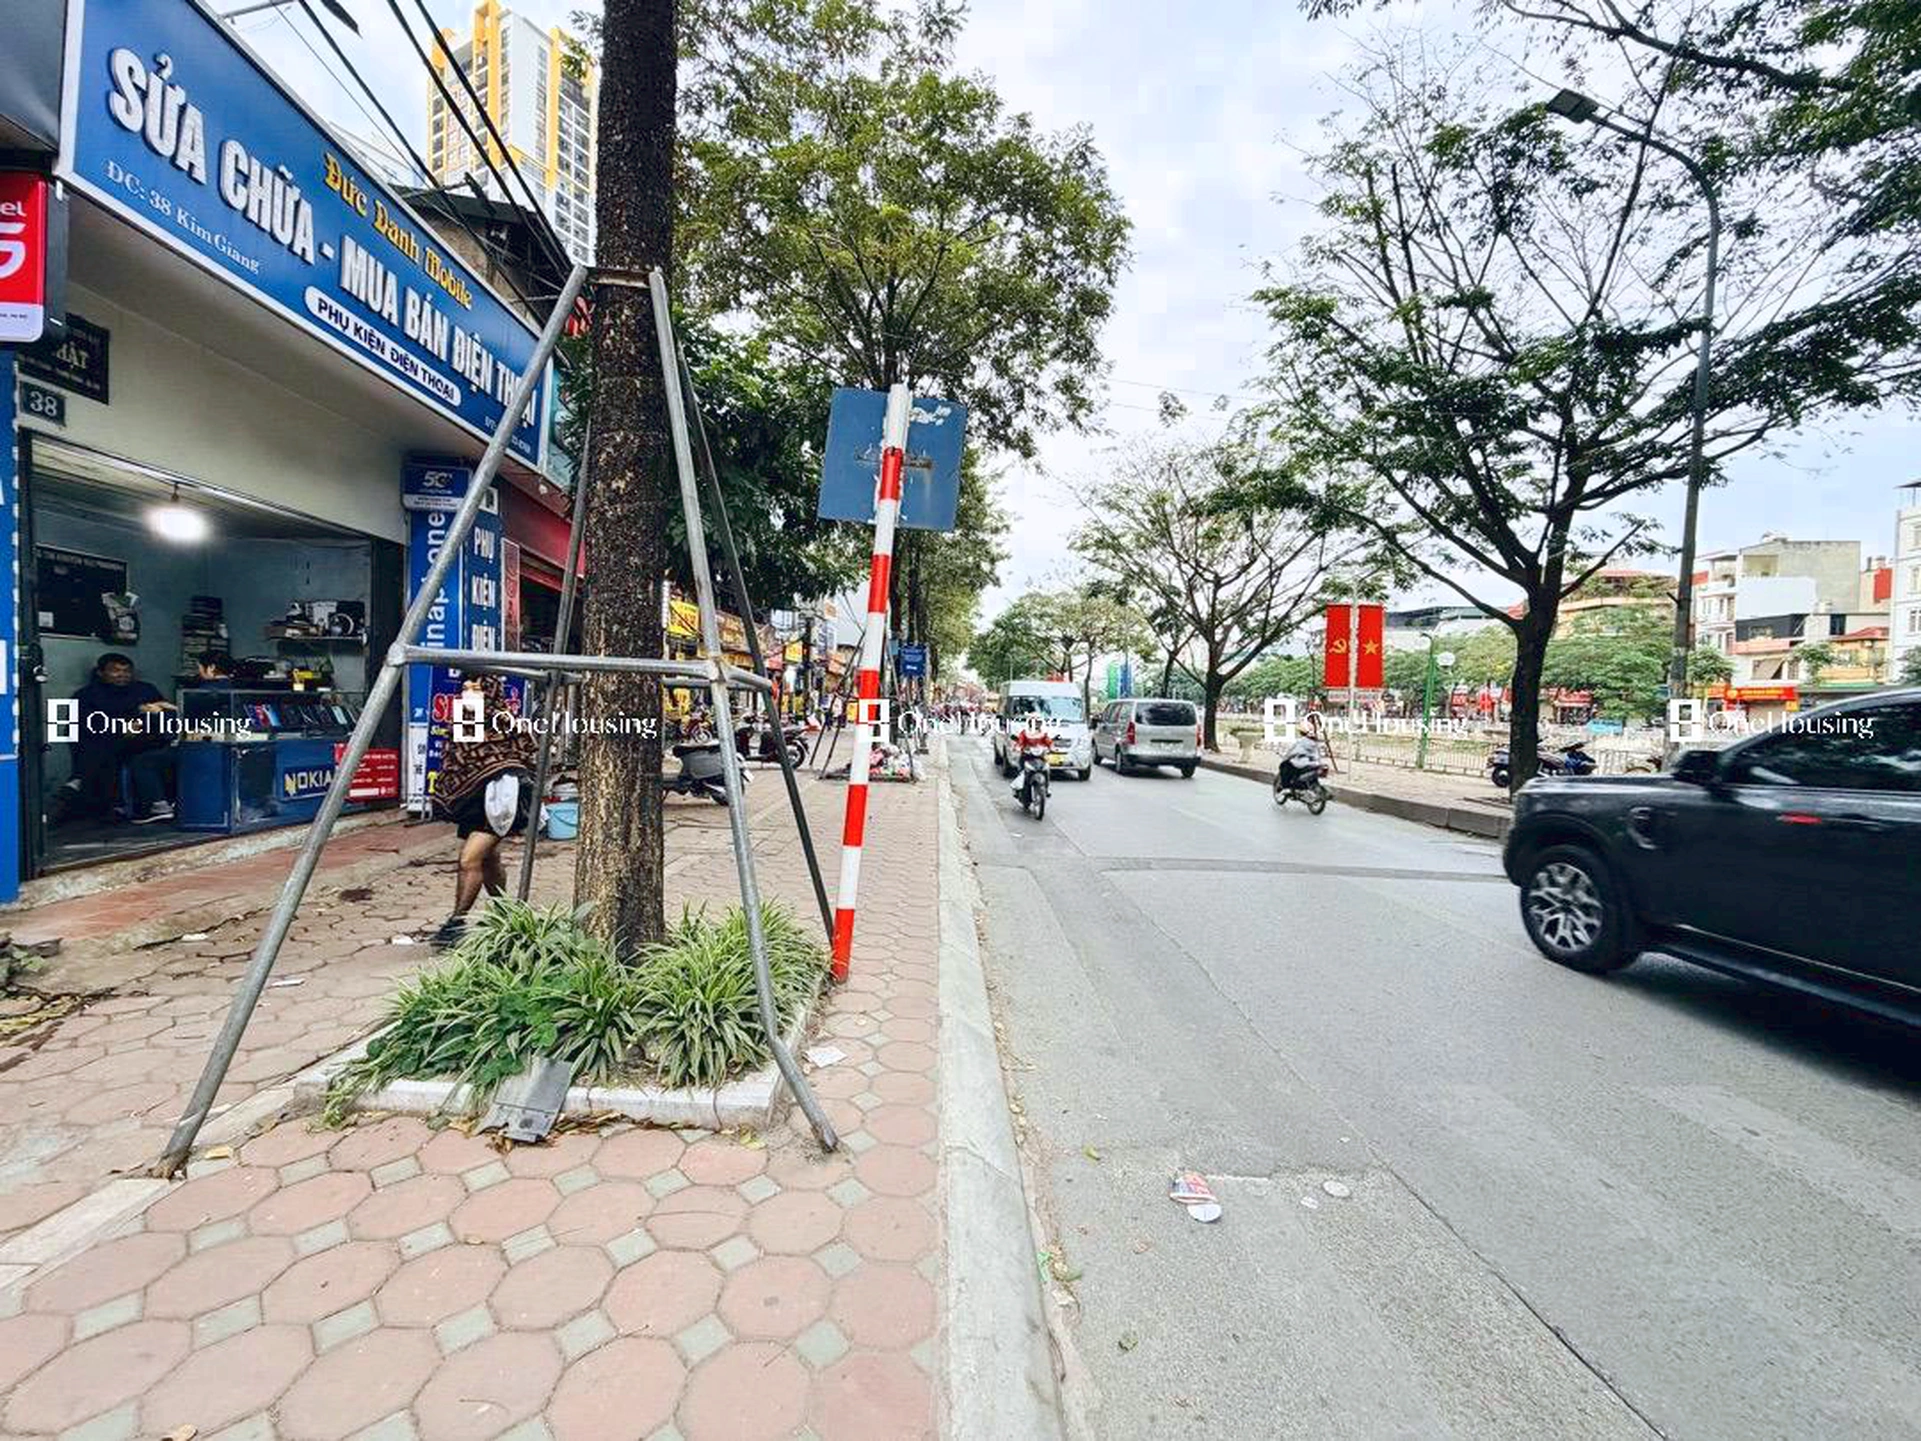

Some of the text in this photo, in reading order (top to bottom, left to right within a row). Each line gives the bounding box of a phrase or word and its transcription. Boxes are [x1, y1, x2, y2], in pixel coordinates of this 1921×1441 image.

[110, 48, 207, 185] SỬA
[220, 139, 315, 266] CHỮA
[341, 234, 399, 326] MUA
[404, 285, 449, 362] BÁN
[453, 325, 493, 394] ĐIỆN
[149, 189, 172, 217] 38
[176, 206, 213, 245] Kim
[213, 232, 260, 276] Giang
[425, 246, 472, 310] Mobile
[318, 297, 455, 401] PHỤ KIỆN ĐIỆN THOẠI
[29, 390, 58, 418] 38
[473, 526, 496, 563] PHỤ
[471, 572, 496, 610] KIỆN
[283, 769, 333, 796] NOKIA
